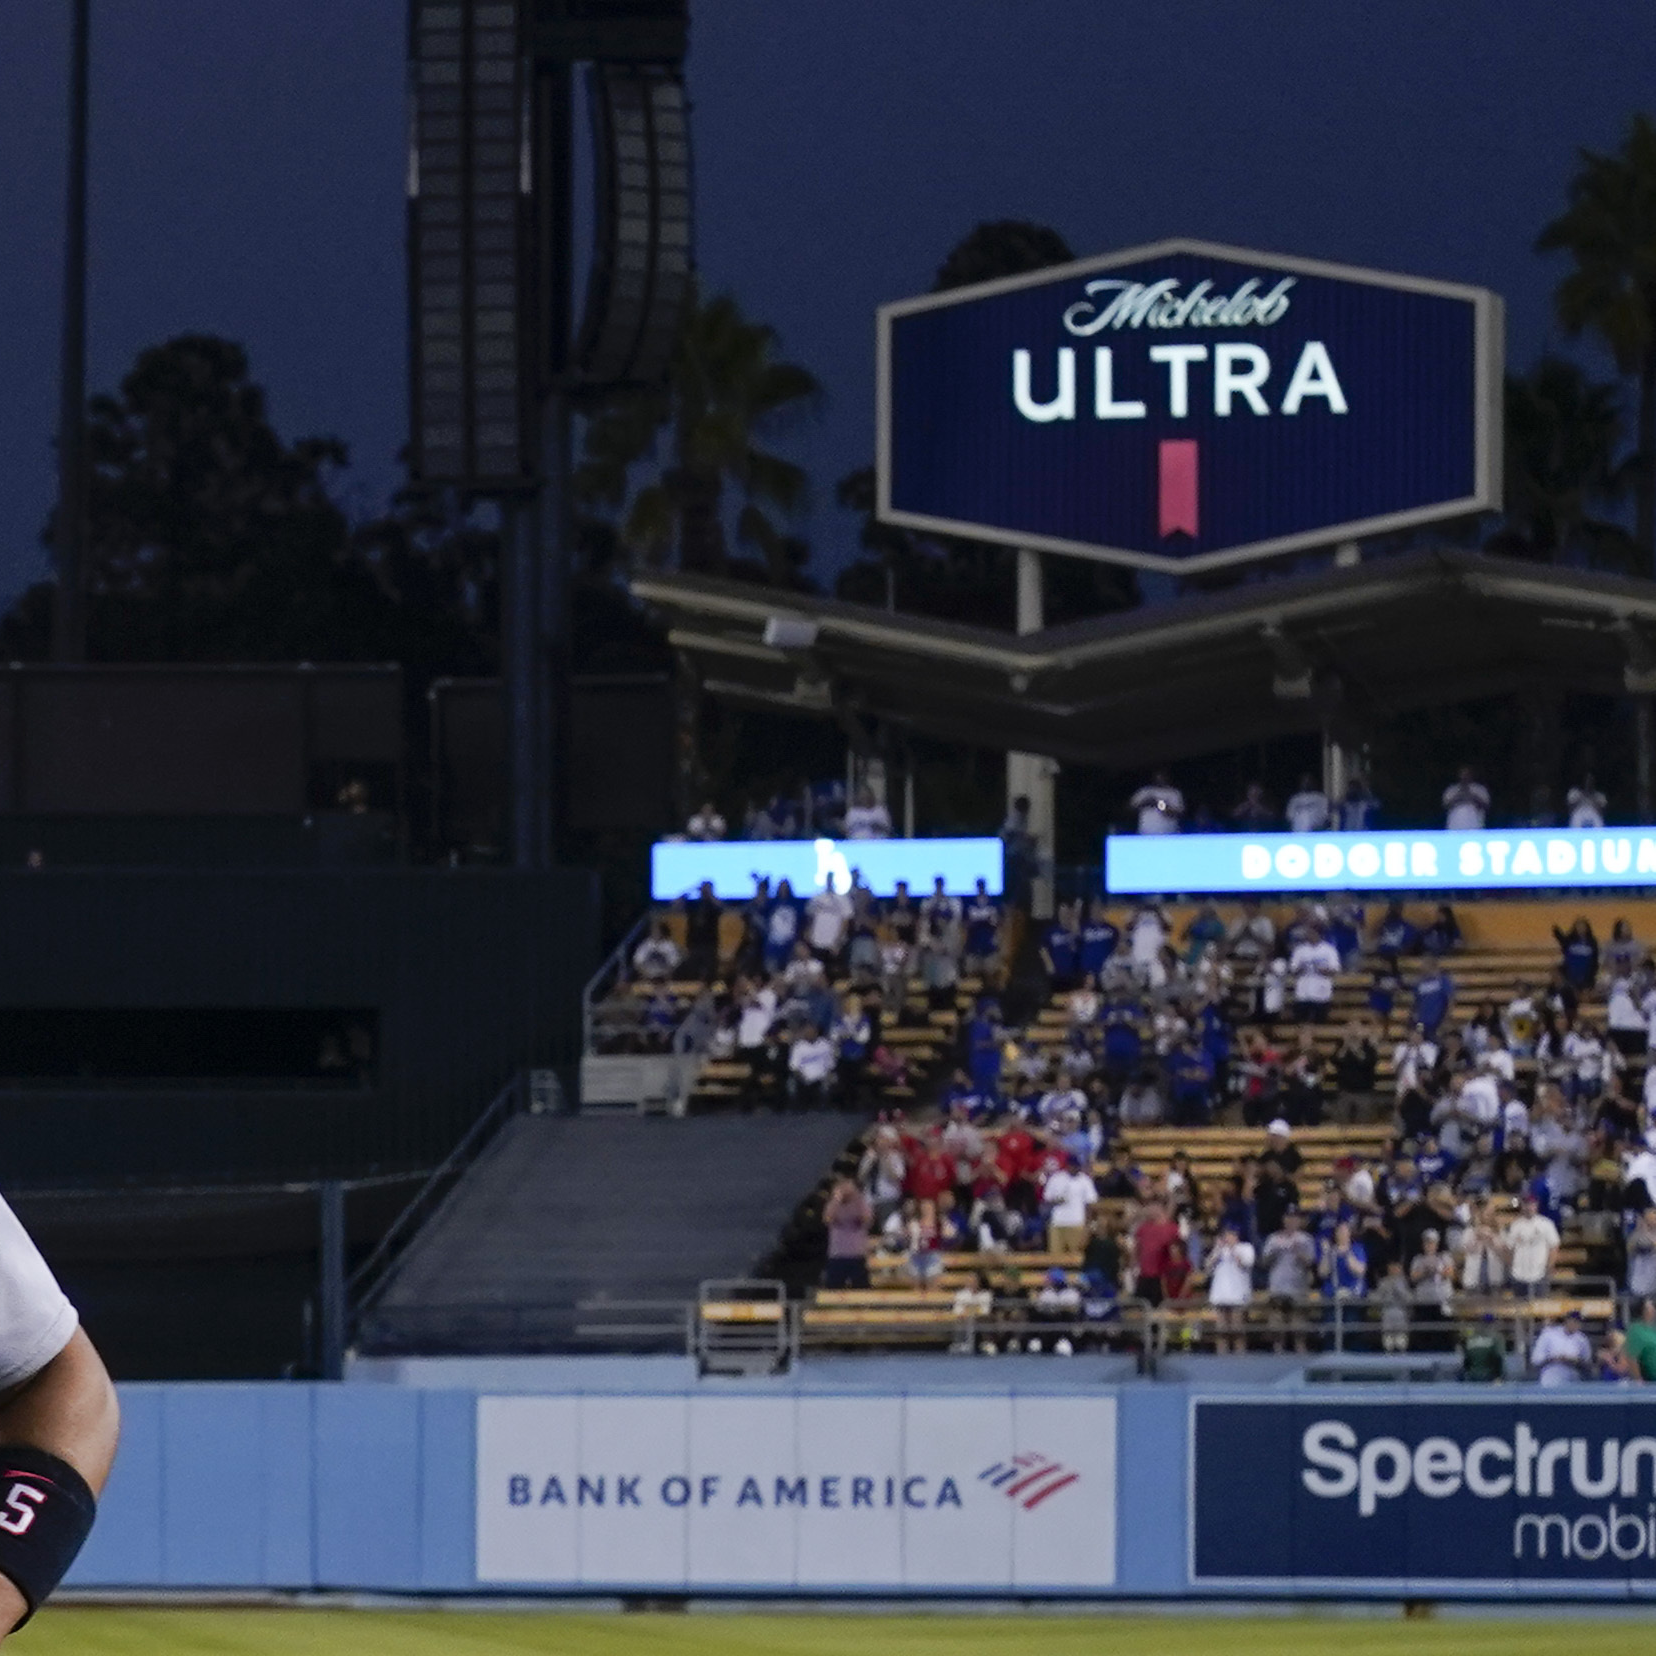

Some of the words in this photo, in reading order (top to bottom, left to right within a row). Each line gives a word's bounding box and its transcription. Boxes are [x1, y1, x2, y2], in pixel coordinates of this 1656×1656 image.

[1062, 276, 1297, 337] Michelob
[1013, 340, 1350, 423] ULTRA
[1239, 840, 1440, 881] DODGER
[505, 1472, 644, 1509] BANK
[657, 1473, 723, 1510] OF
[733, 1474, 966, 1511] AMERICA
